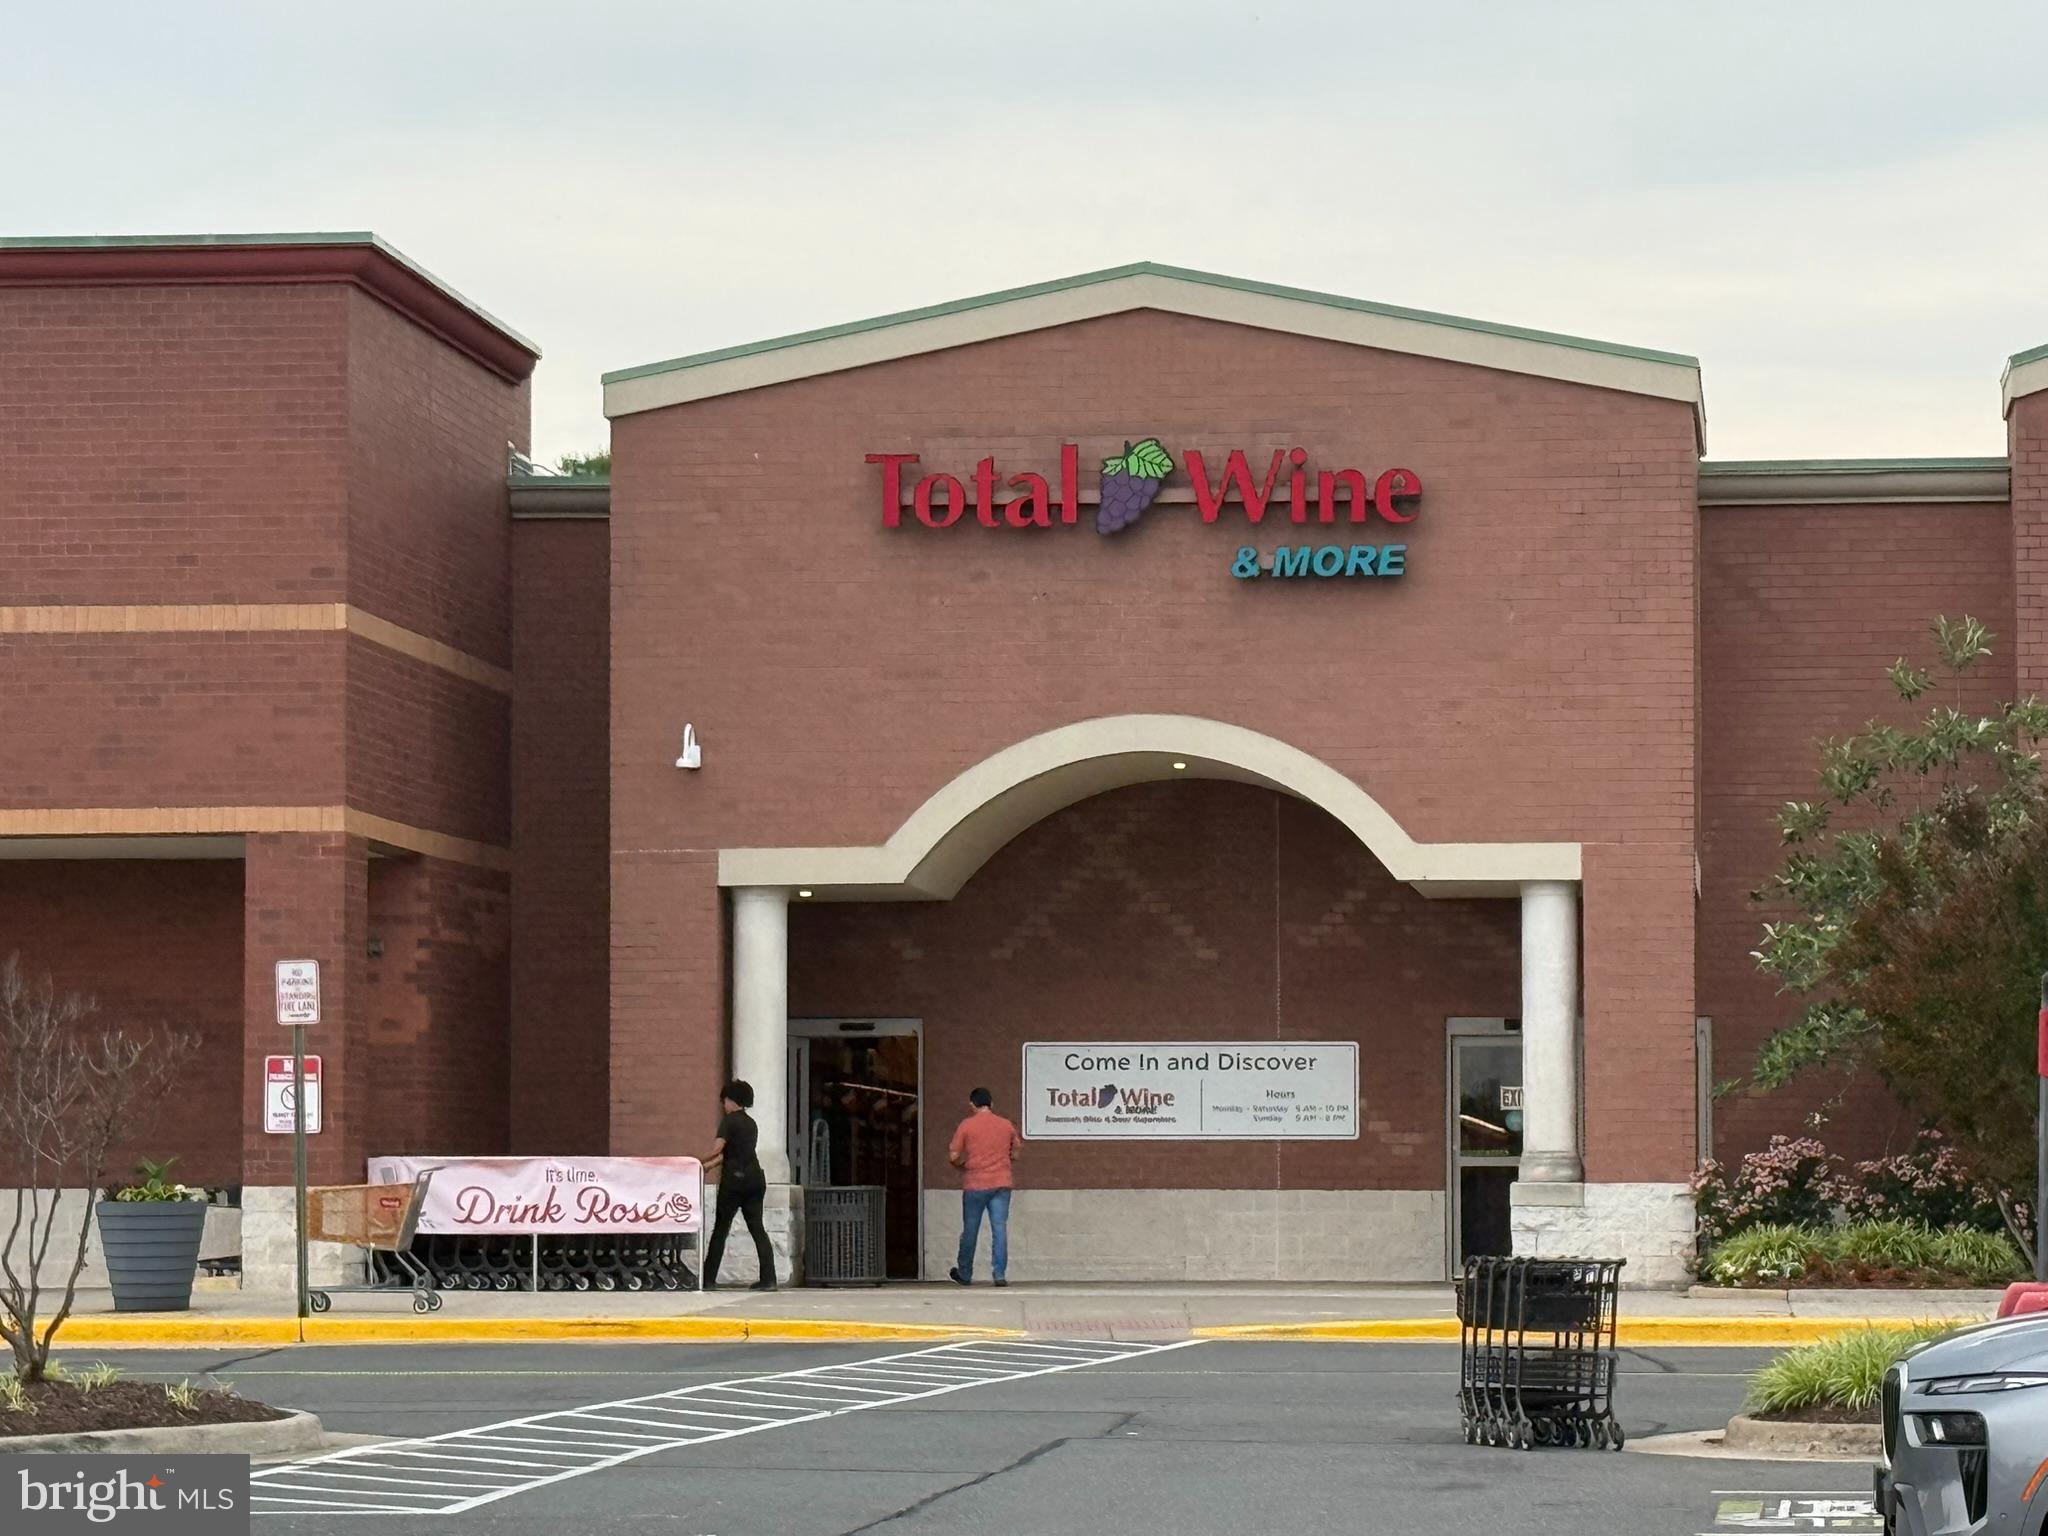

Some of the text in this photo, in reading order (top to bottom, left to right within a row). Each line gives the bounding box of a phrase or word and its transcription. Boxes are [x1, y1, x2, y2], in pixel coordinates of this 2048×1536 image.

[864, 444, 1422, 528] Total Wine
[1230, 544, 1407, 579] & MORE
[1064, 1052, 1318, 1071] Come In and Discover
[1046, 1086, 1176, 1107] Total Wine
[1266, 1089, 1296, 1099] Hours
[1503, 1088, 1522, 1106] EXI
[545, 1167, 564, 1183] It's
[453, 1186, 666, 1224] Drink Rosé
